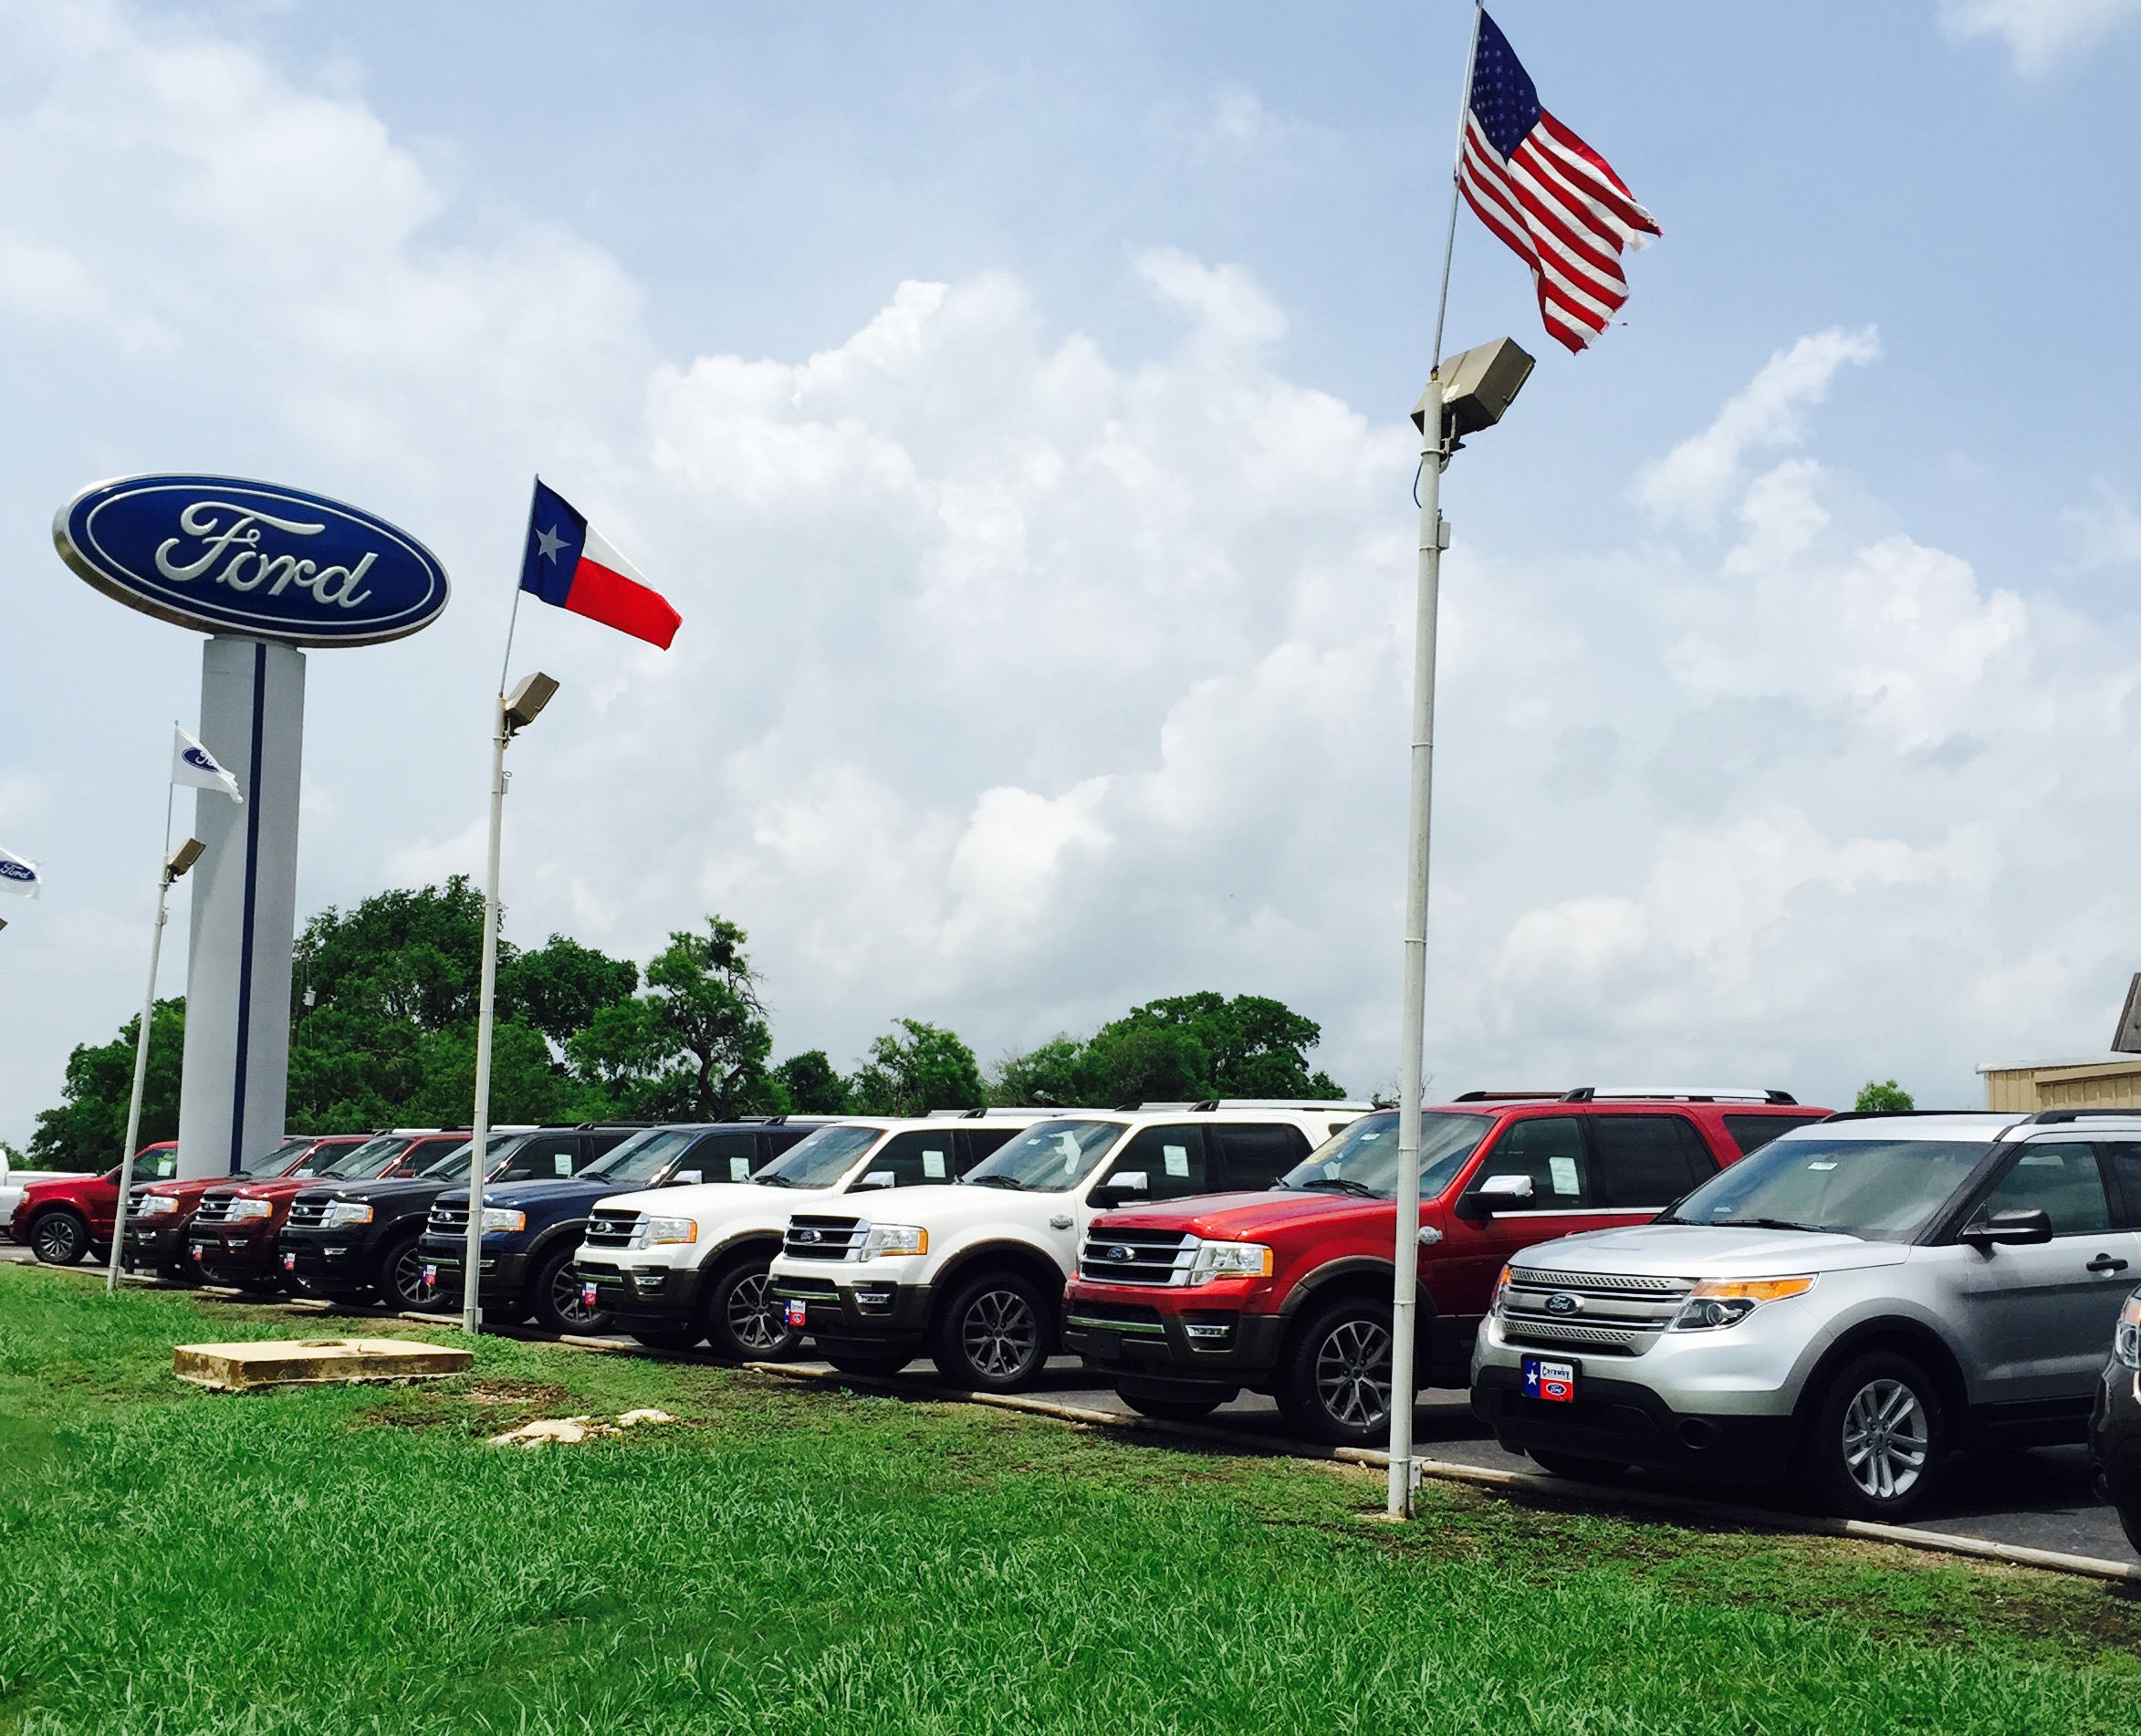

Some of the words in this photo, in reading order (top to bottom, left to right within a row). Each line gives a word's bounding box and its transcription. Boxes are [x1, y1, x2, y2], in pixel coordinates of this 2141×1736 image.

[154, 500, 379, 609] Ford
[0, 863, 31, 879] Ford
[1549, 1296, 1570, 1310] Ford
